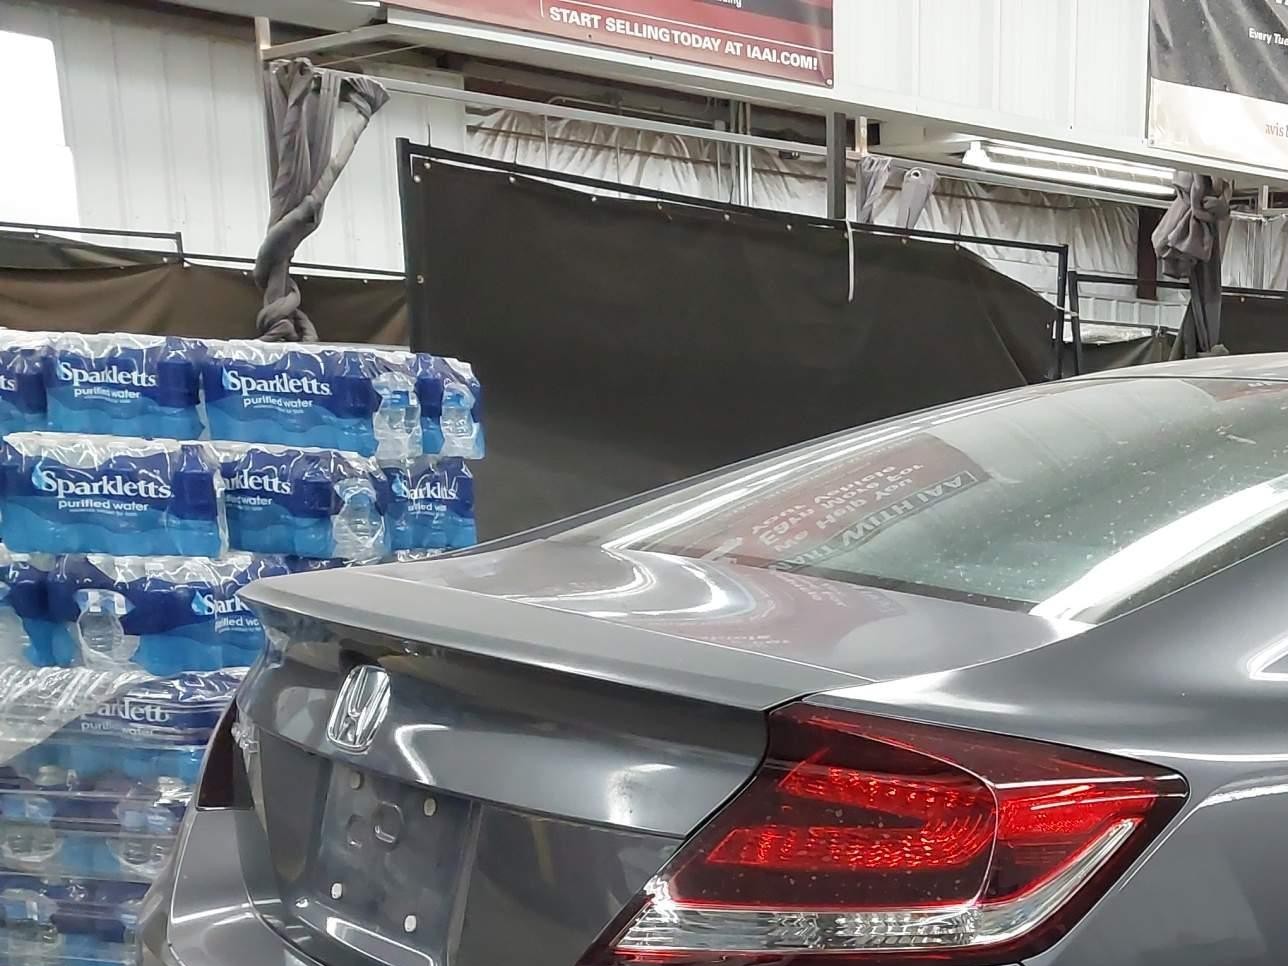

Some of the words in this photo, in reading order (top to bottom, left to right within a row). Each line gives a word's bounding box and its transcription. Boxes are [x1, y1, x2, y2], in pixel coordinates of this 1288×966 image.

[549, 6, 601, 29] START
[605, 17, 670, 42] SELLING
[671, 30, 721, 52] TODAY
[725, 41, 742, 55] AT
[747, 44, 818, 71] IAAI.COM!
[1248, 28, 1272, 44] Every
[1264, 122, 1284, 137] avis
[59, 361, 156, 388] Sparkletts
[228, 370, 330, 396] Sparkletts
[243, 395, 282, 408] purified
[283, 398, 313, 408] water
[42, 470, 172, 498] Sparkletts
[58, 499, 110, 510] purified
[112, 502, 149, 511] water
[241, 496, 272, 505] water
